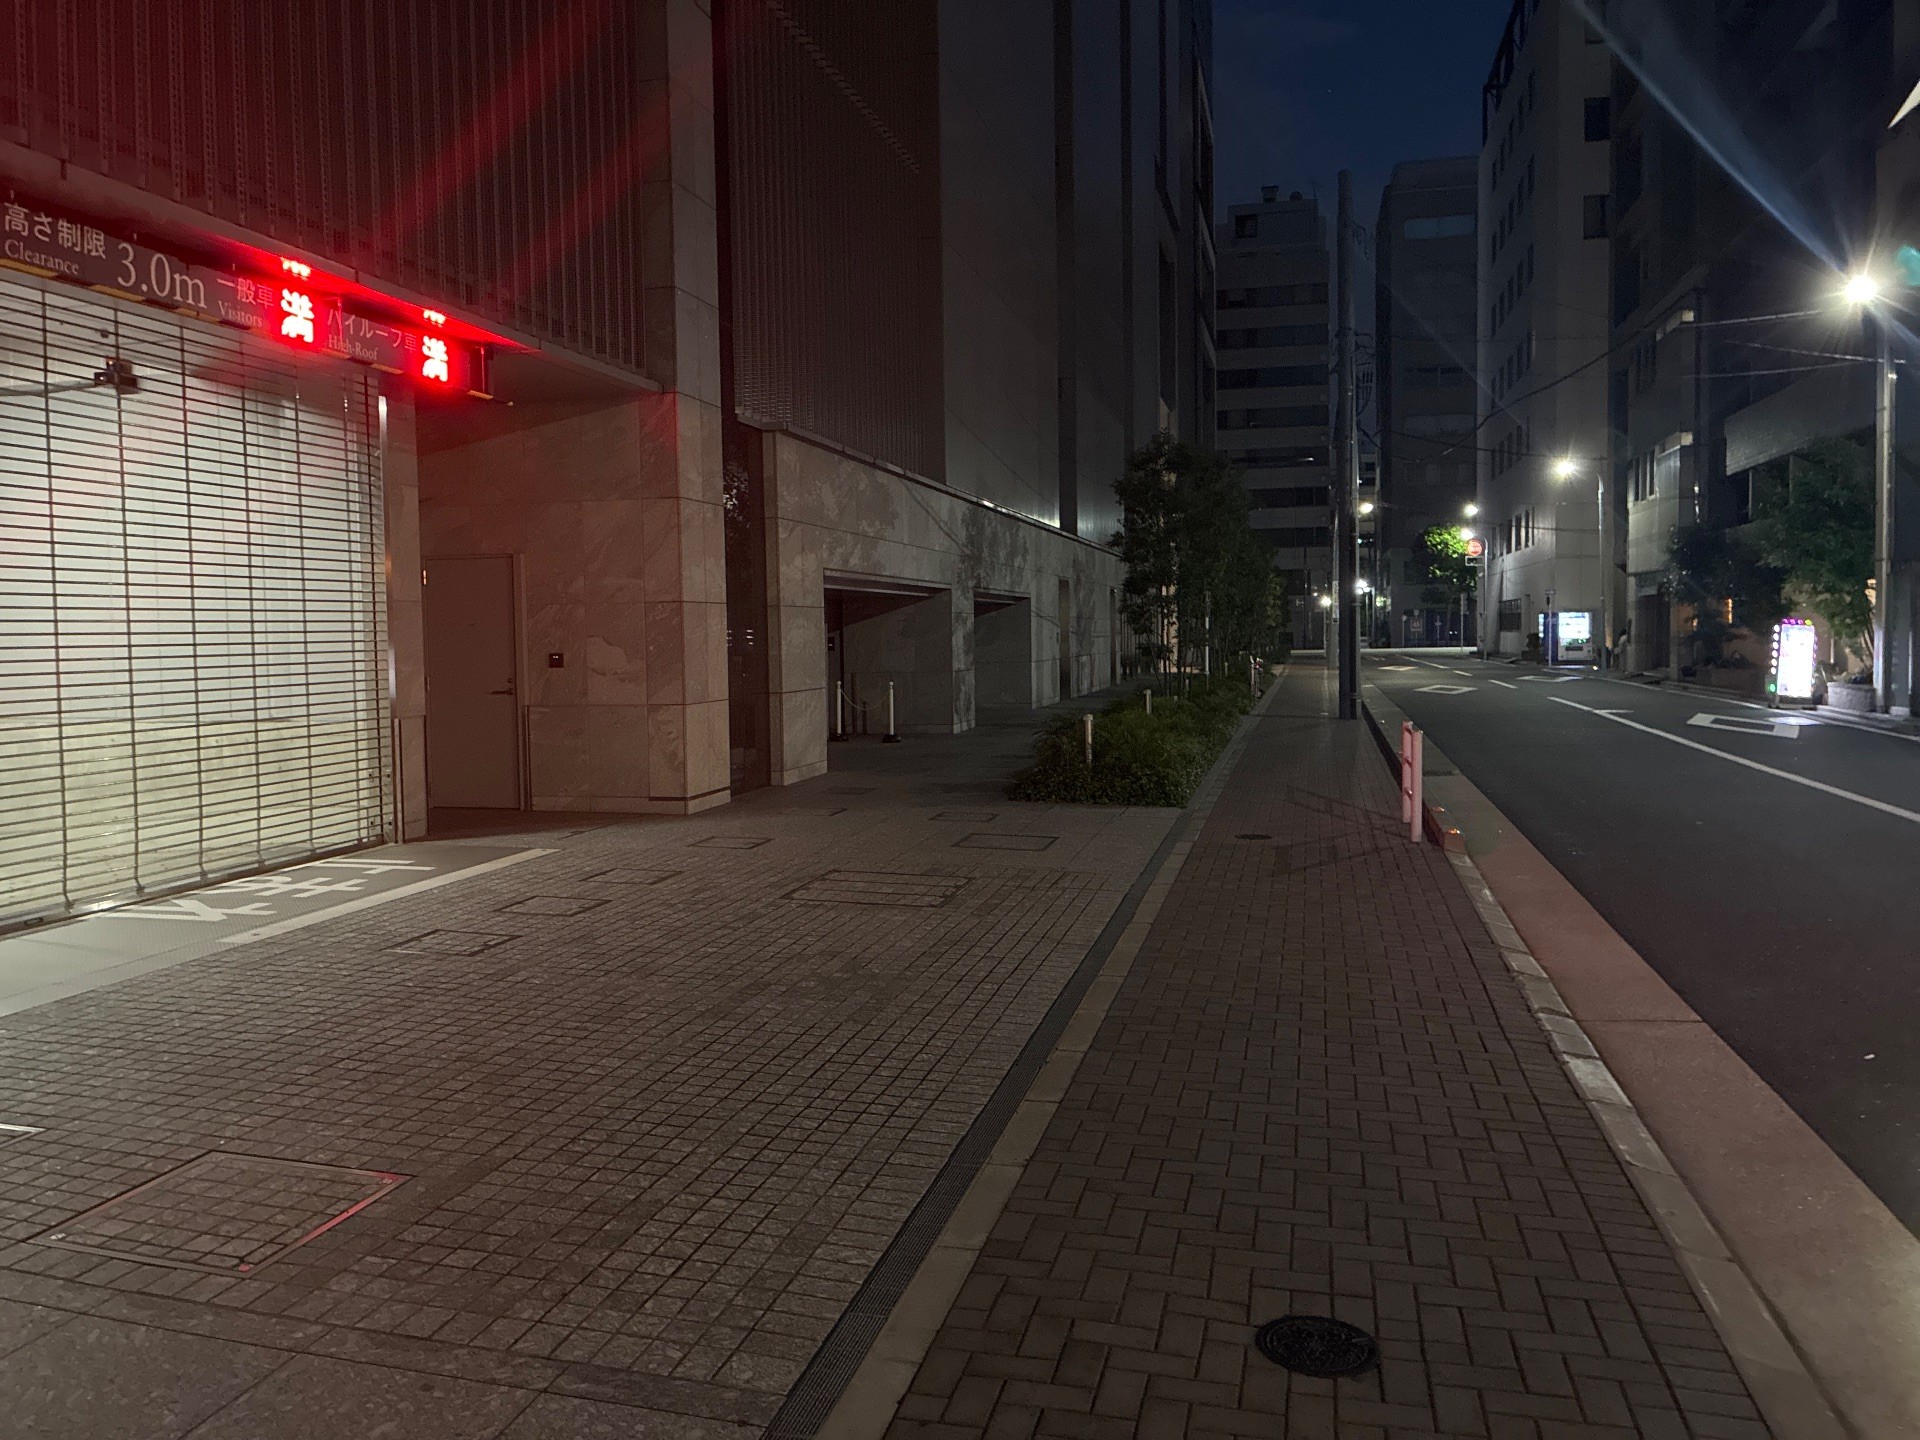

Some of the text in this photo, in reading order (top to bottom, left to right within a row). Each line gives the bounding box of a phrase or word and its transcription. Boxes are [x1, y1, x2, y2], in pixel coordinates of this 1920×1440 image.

[4, 202, 106, 259] 高さ制限
[5, 239, 79, 275] Clearance
[117, 242, 207, 308] 3.0m
[216, 276, 274, 310] 一般車
[218, 300, 263, 326] Visitors
[280, 287, 315, 343] 満
[328, 308, 417, 353] ハイルーフ車
[422, 335, 449, 382] 満
